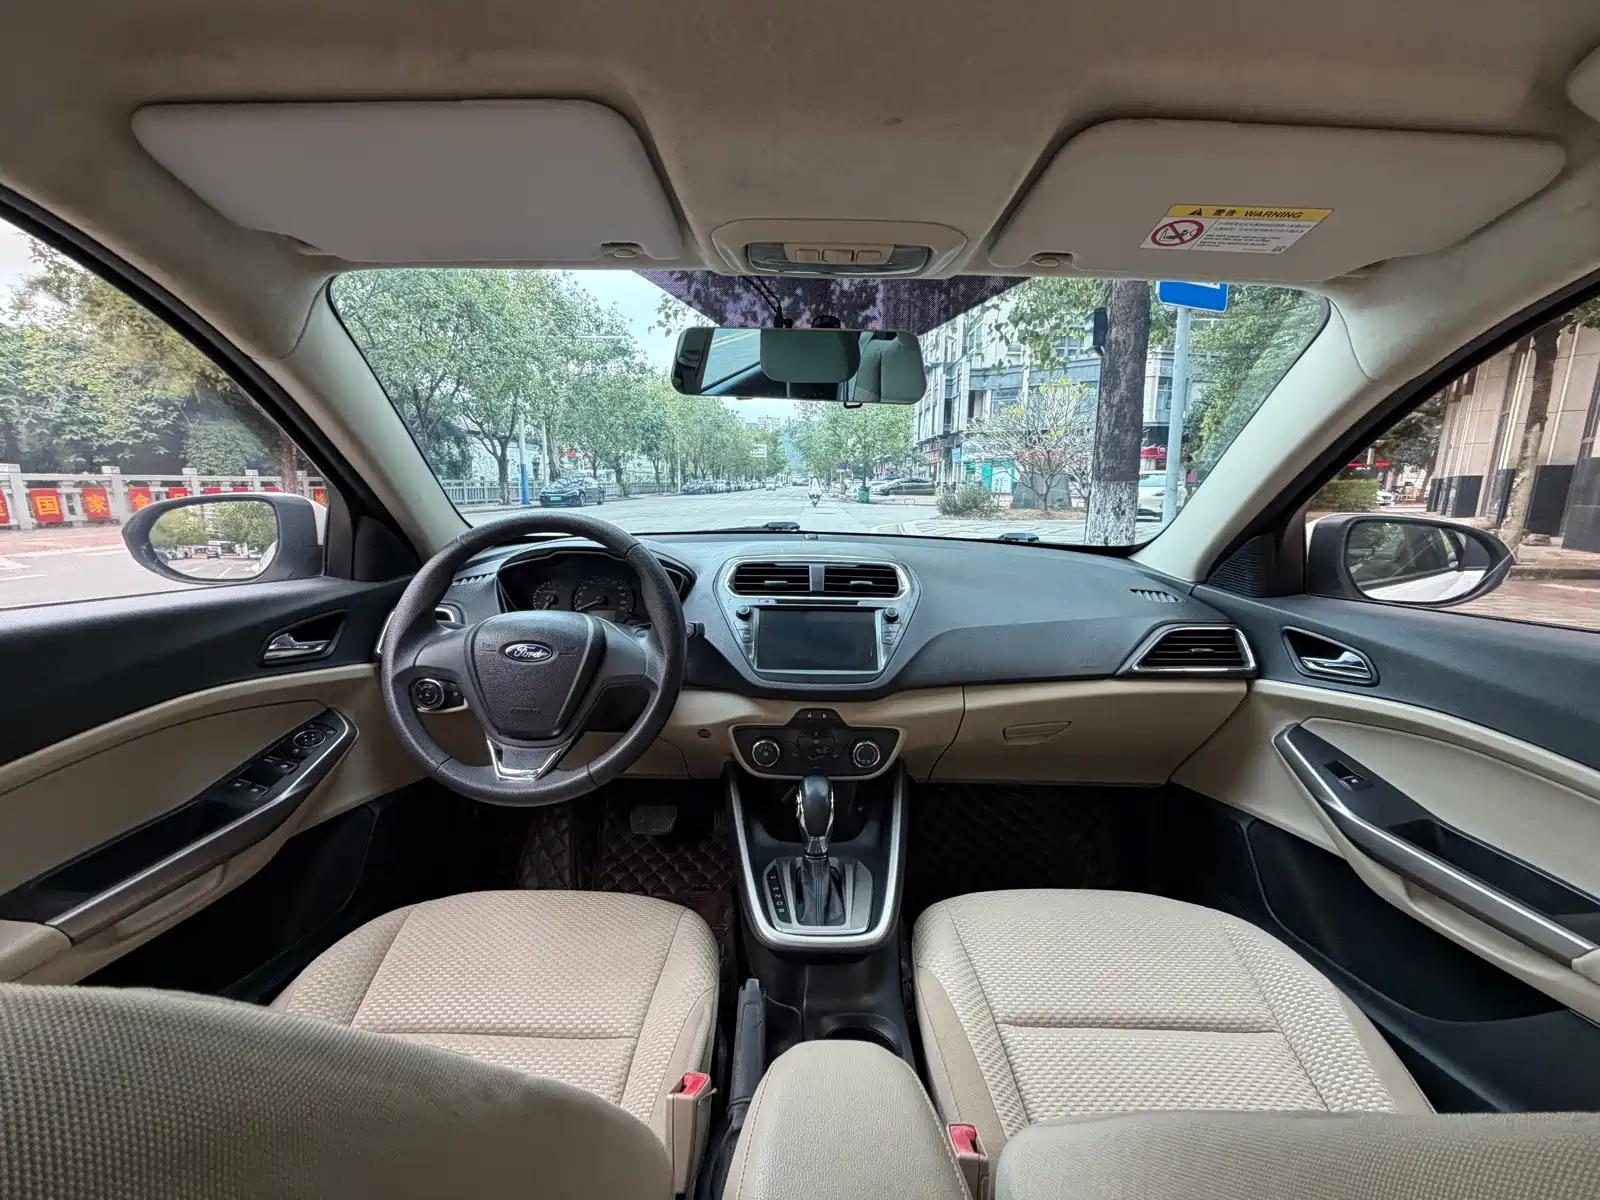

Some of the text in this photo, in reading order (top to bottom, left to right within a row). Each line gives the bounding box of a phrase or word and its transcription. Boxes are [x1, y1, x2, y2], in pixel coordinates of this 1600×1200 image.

[1213, 208, 1237, 217] 警告
[1244, 210, 1304, 219] WARNING
[35, 495, 60, 516] 国
[83, 494, 108, 514] 家
[513, 646, 547, 658] Ford
